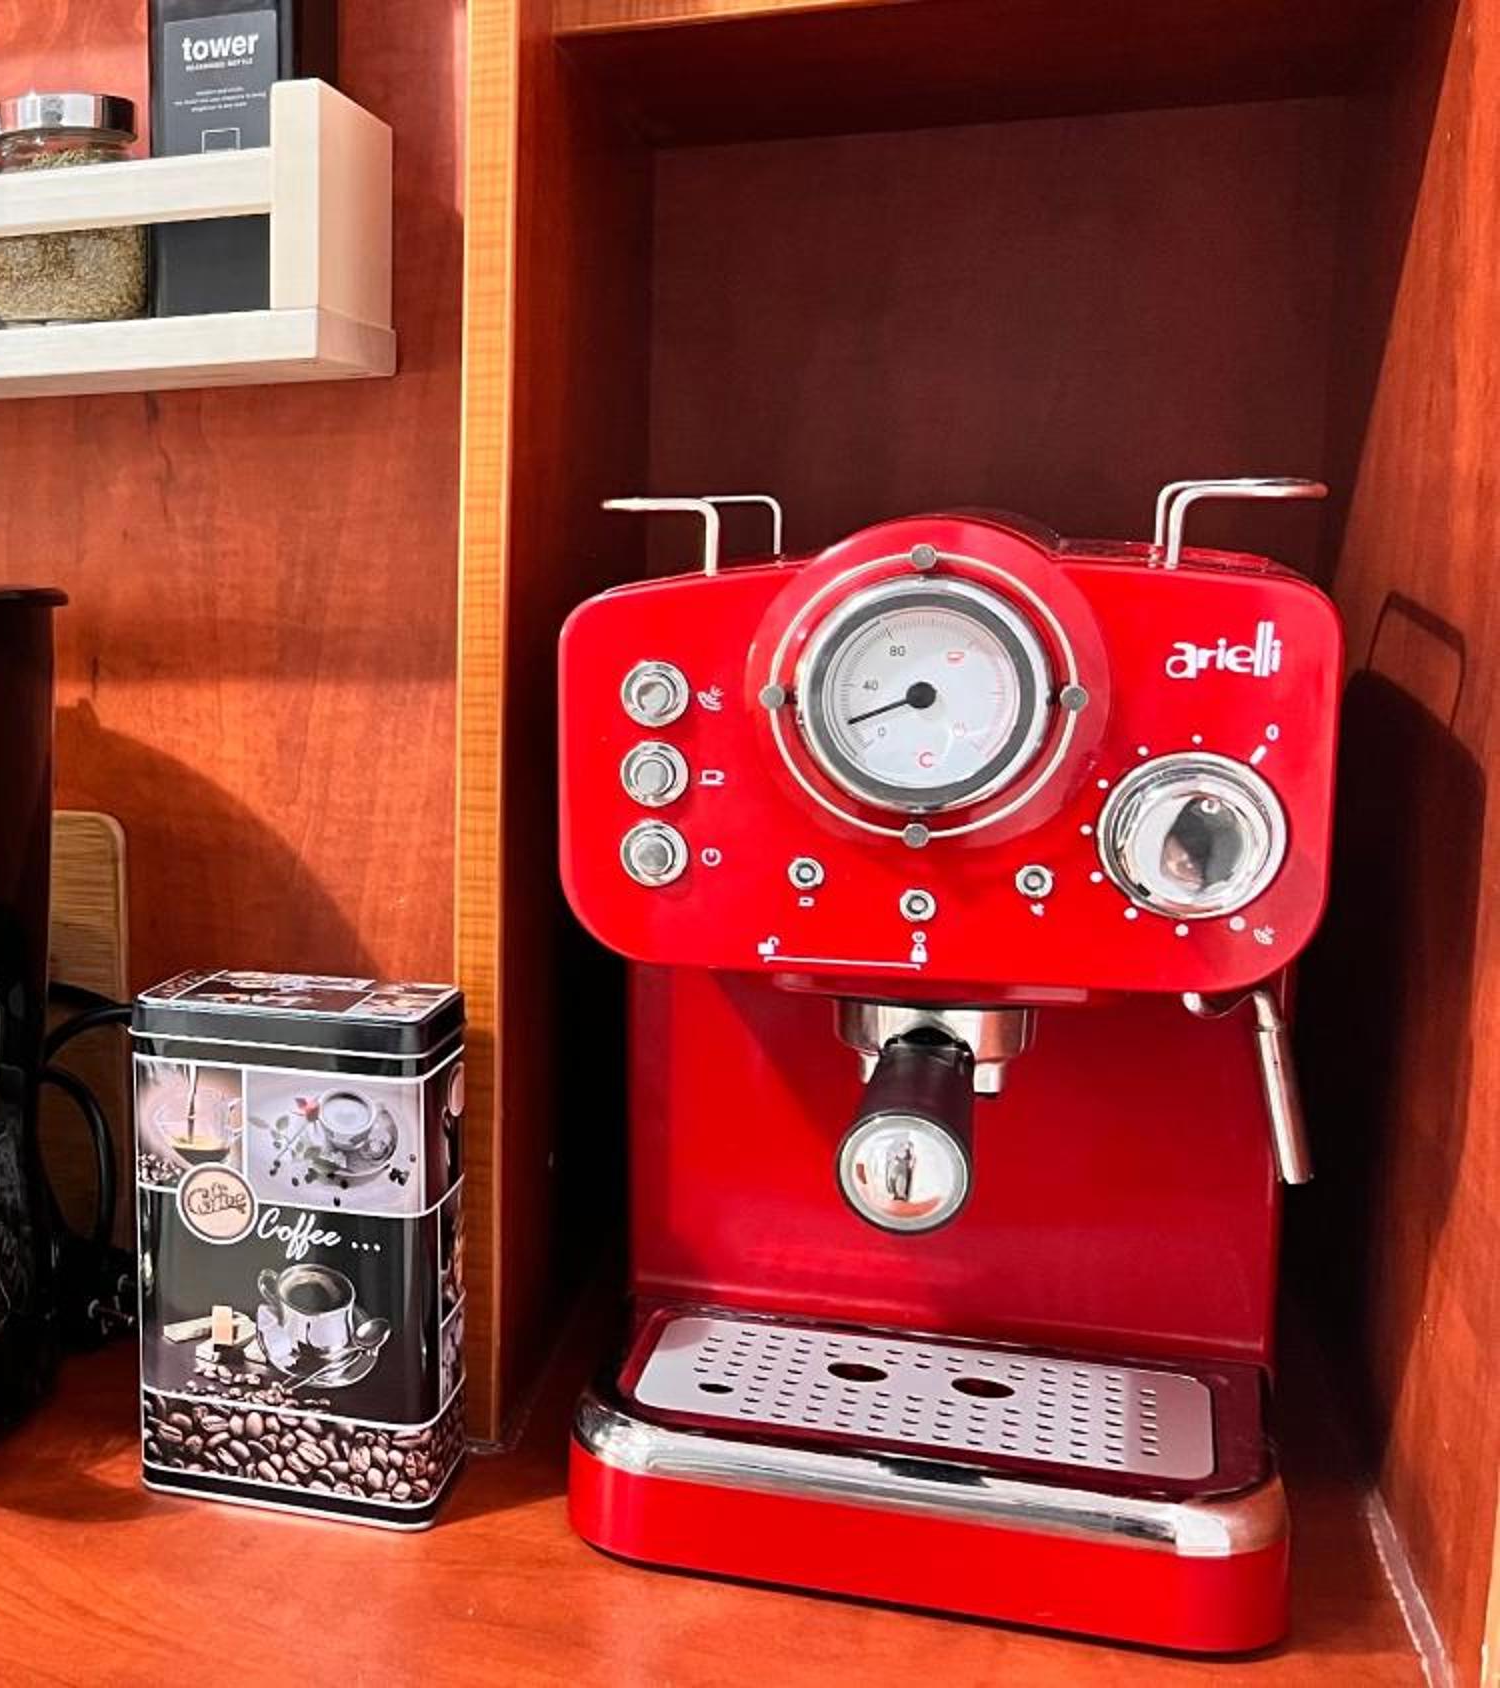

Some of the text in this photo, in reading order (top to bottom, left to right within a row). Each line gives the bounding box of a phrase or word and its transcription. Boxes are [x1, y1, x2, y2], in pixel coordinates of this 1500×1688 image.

[181, 33, 259, 61] tower
[888, 645, 907, 657] 80
[1165, 621, 1283, 678] arielli
[861, 680, 879, 692] 40
[877, 727, 887, 738] 0
[257, 1207, 342, 1260] Coffee
